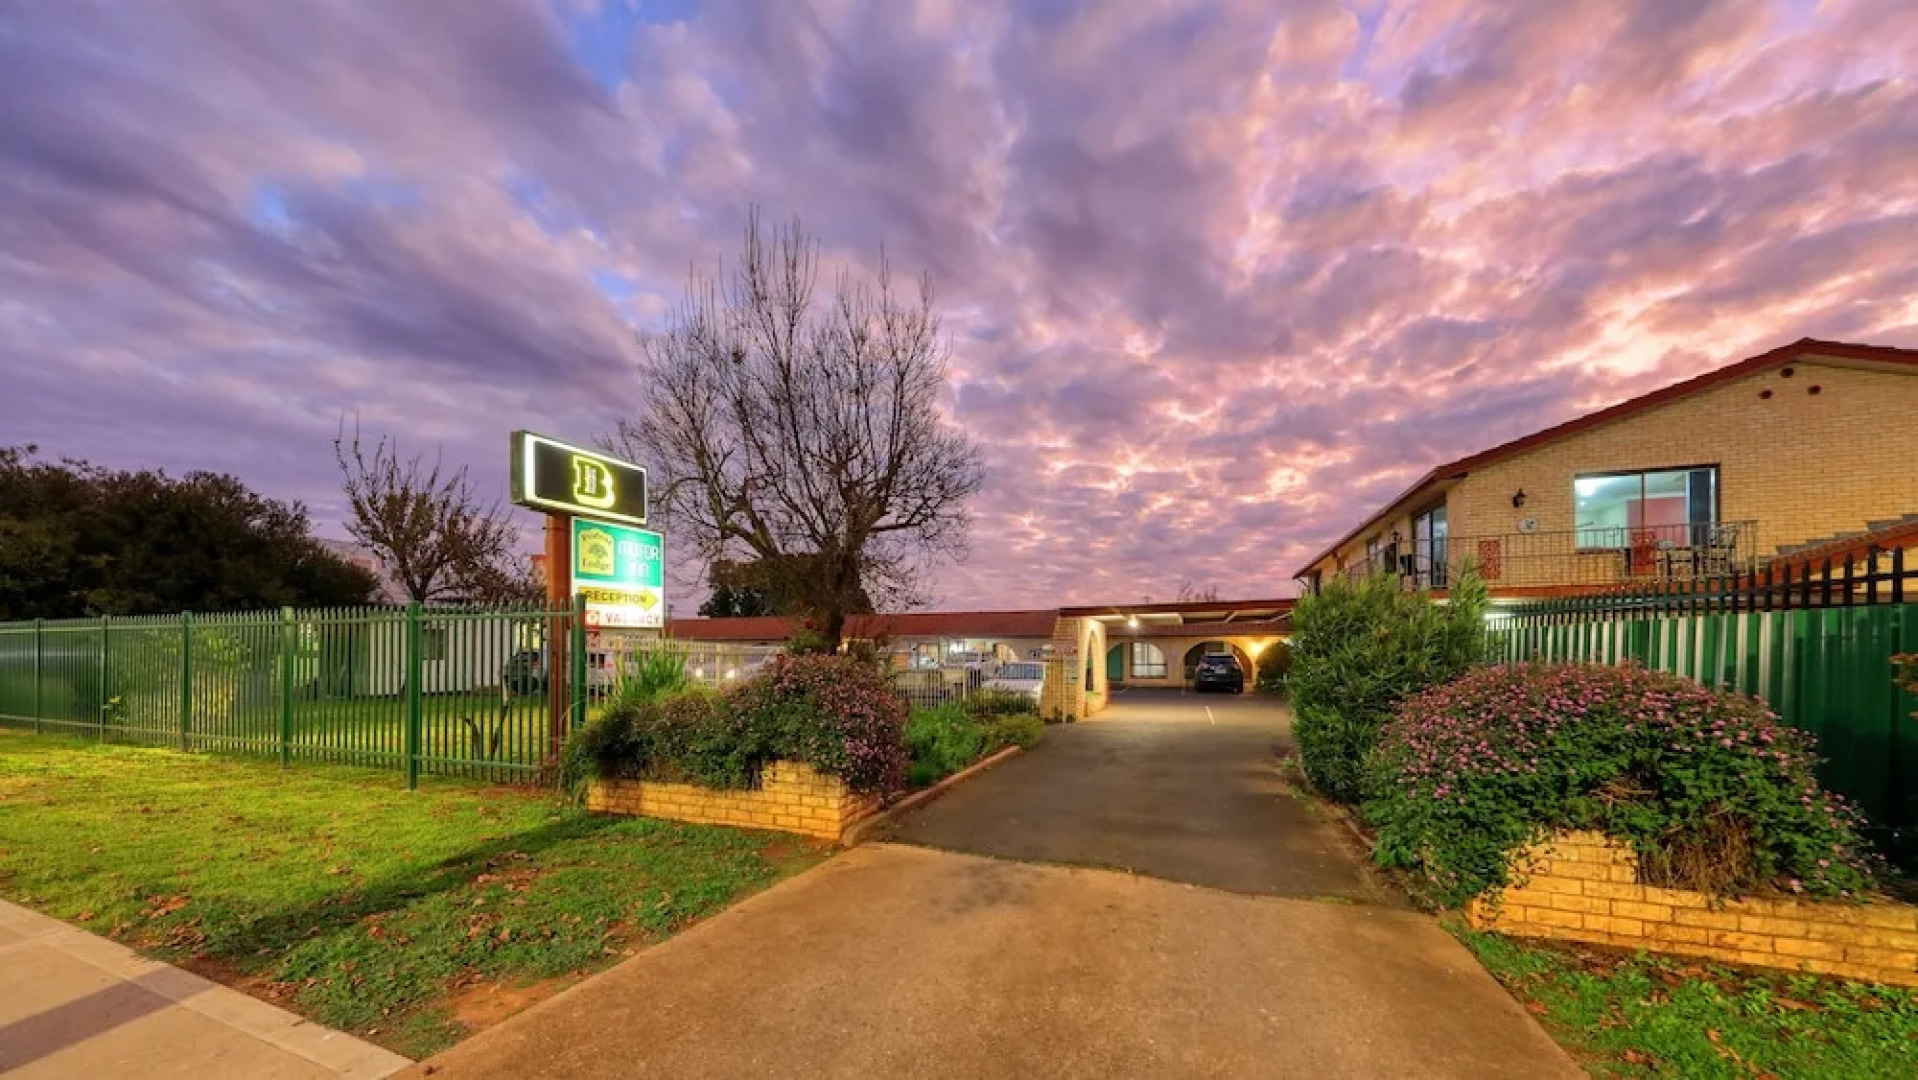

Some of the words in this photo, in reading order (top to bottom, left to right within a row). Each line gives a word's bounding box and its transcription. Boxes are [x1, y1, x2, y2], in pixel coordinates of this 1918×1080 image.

[617, 541, 659, 560] MOTOR
[584, 590, 647, 603] RECEPTION
[605, 612, 660, 626] VACNCY
